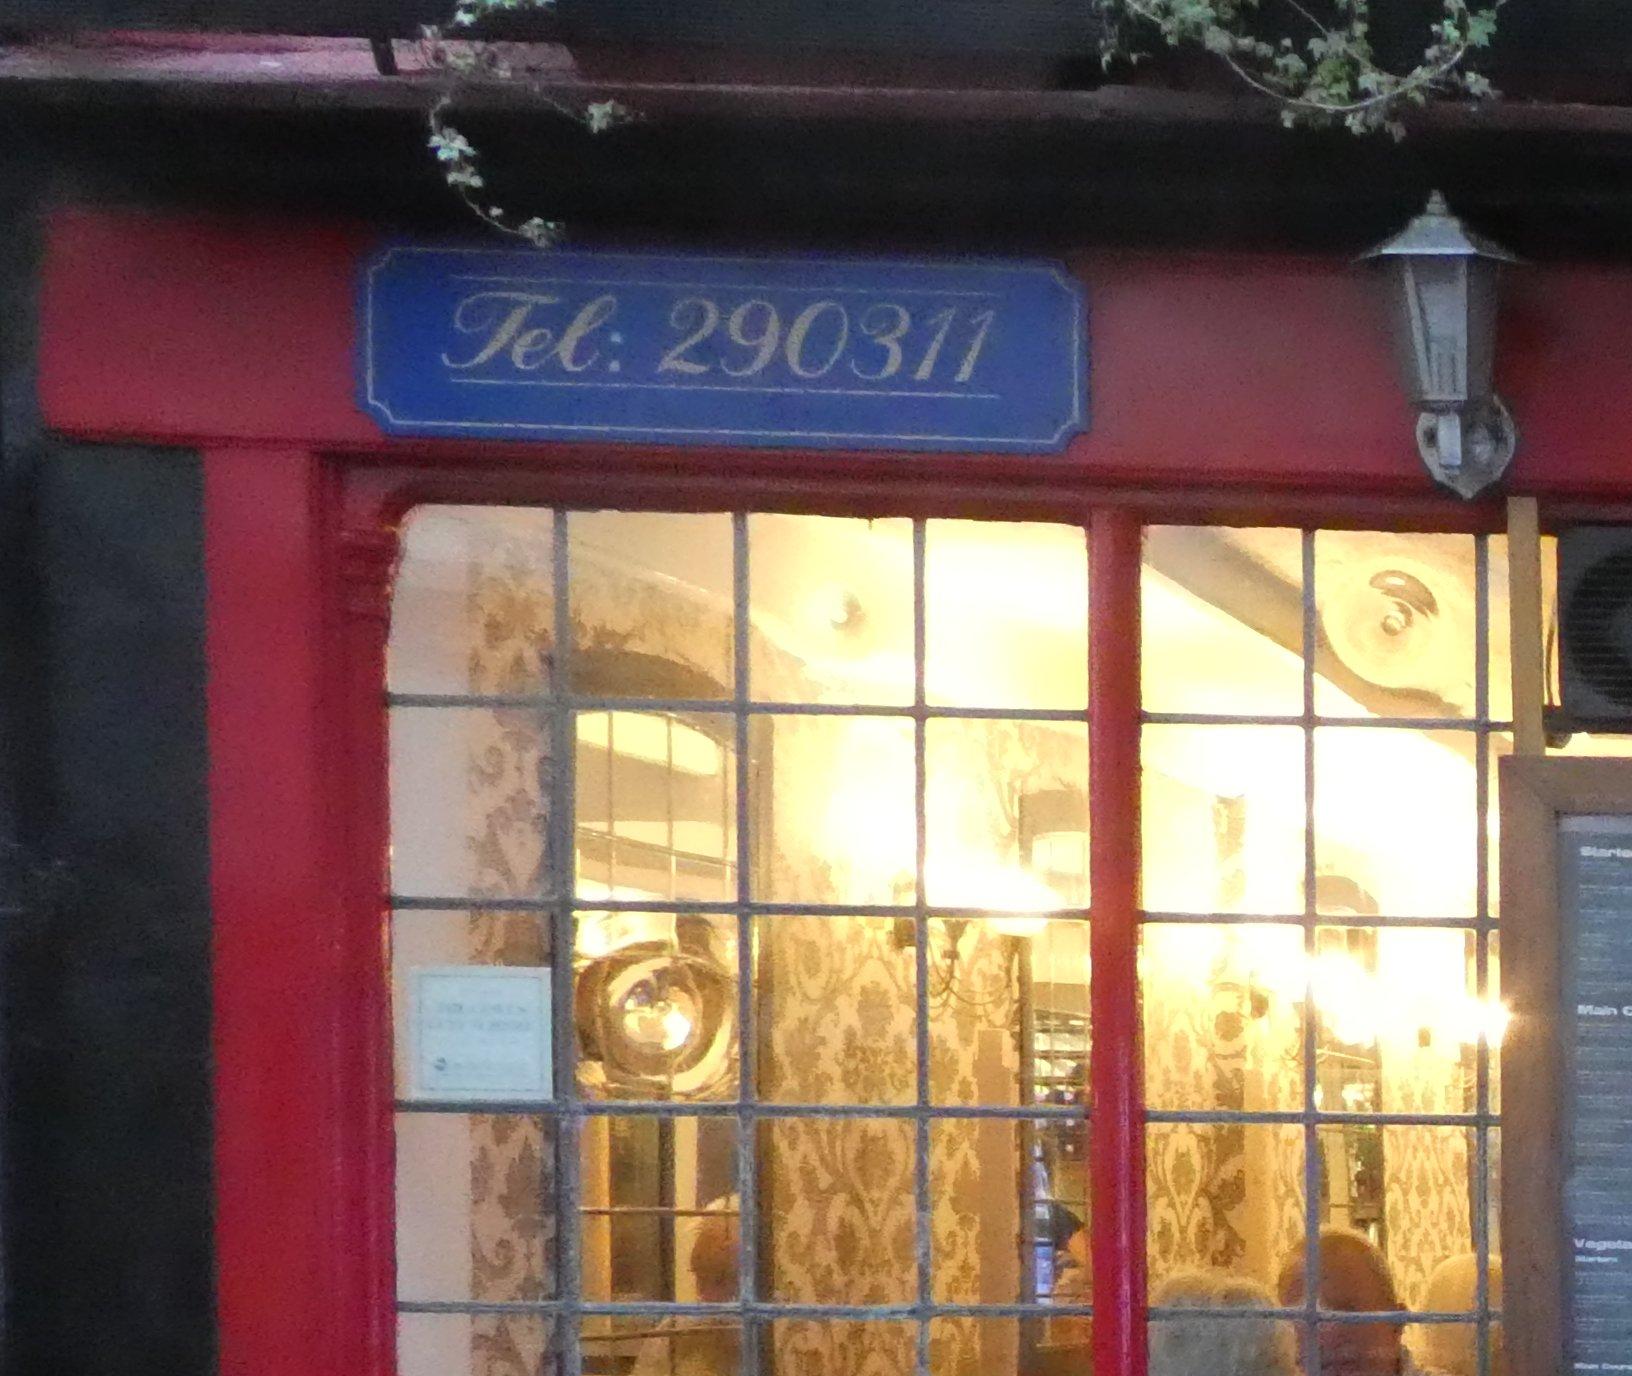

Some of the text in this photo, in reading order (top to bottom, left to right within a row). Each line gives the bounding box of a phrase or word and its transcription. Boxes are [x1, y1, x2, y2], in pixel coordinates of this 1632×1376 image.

[443, 290, 996, 385] Tel: 290311
[1577, 1004, 1618, 1017] Main
